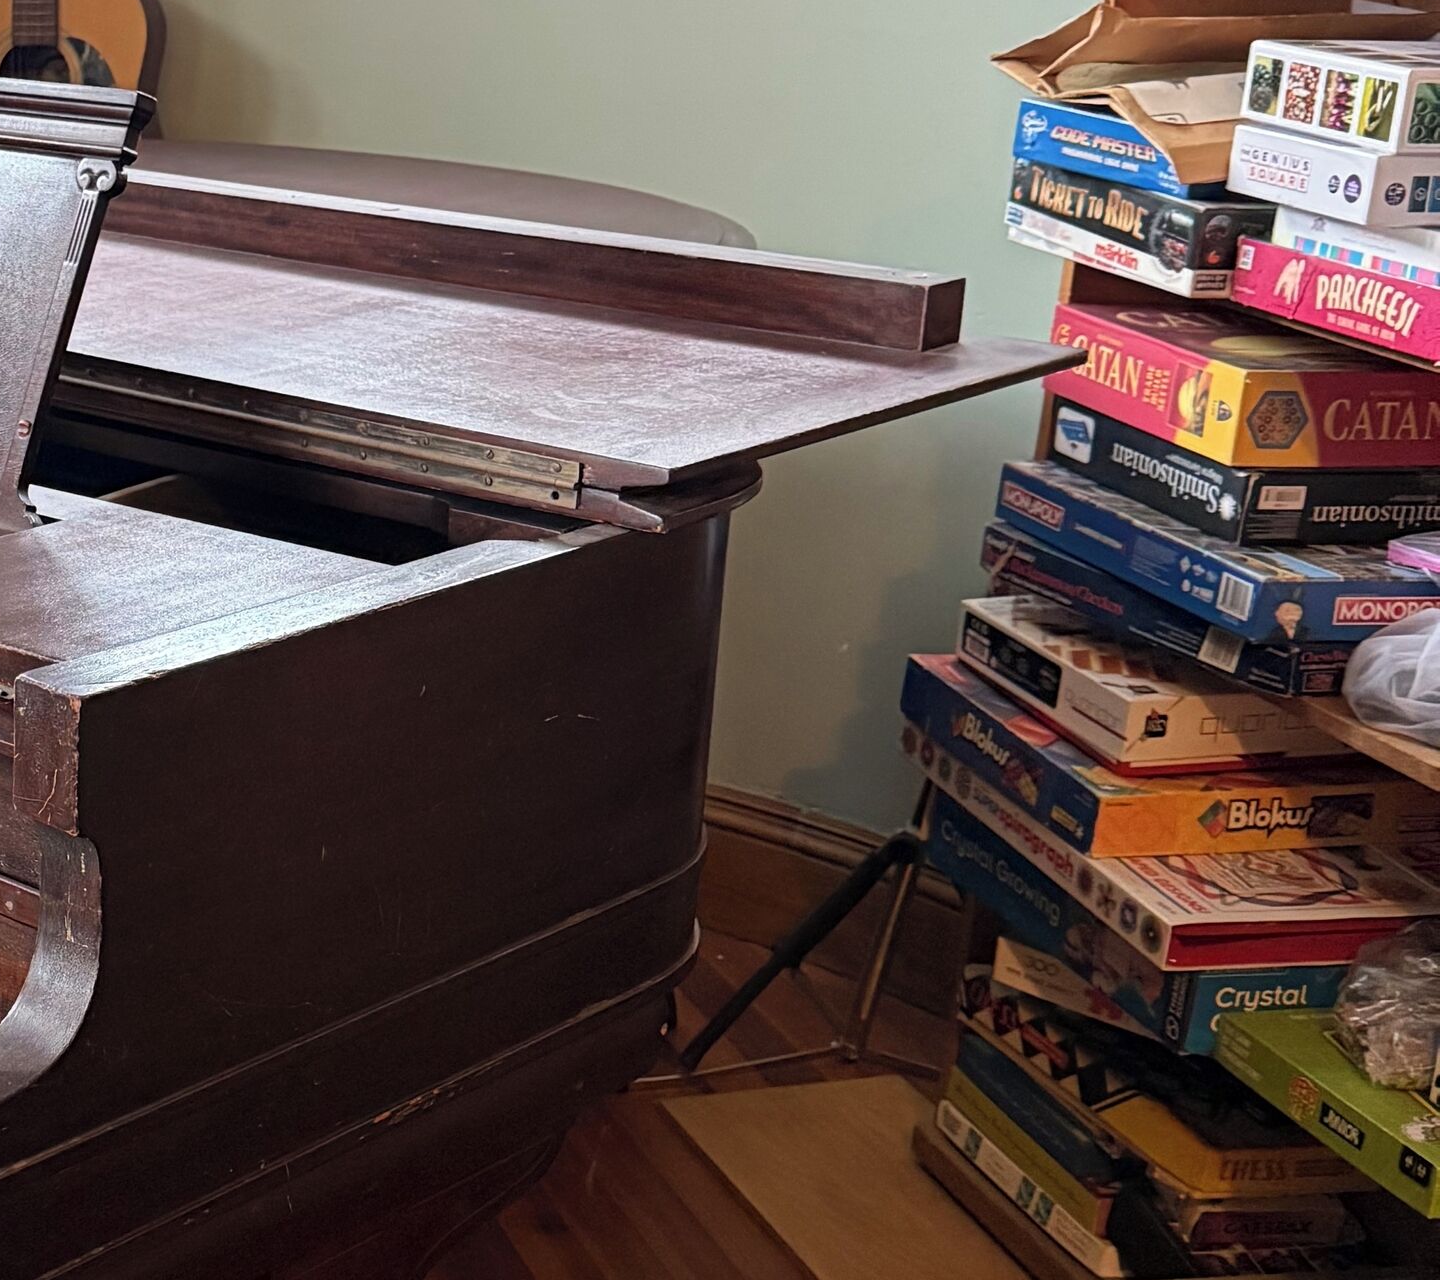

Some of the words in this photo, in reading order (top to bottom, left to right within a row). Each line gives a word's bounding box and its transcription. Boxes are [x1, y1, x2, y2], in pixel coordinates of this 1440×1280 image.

[1050, 125, 1092, 147] CODE
[1091, 134, 1157, 162] MASTER
[1252, 150, 1310, 171] GENIUS
[1248, 166, 1307, 189] SQUARE
[1029, 166, 1089, 218] TICKET
[1086, 196, 1104, 220] TO
[1102, 190, 1148, 240] RIDE
[1316, 274, 1424, 338] PARCHEESI
[1072, 334, 1144, 398] CATAN
[1110, 442, 1220, 514] Smithsonian
[1006, 486, 1062, 528] MONOPOLY
[1312, 504, 1440, 529] mithsonian
[961, 711, 1010, 766] Blokus
[1228, 797, 1314, 833] Blokus
[996, 806, 1074, 878] spirograph
[941, 820, 995, 872] Crystal
[996, 860, 1061, 927] Growing
[1215, 984, 1308, 1012] Crystal
[1219, 1159, 1287, 1181] CHESS
